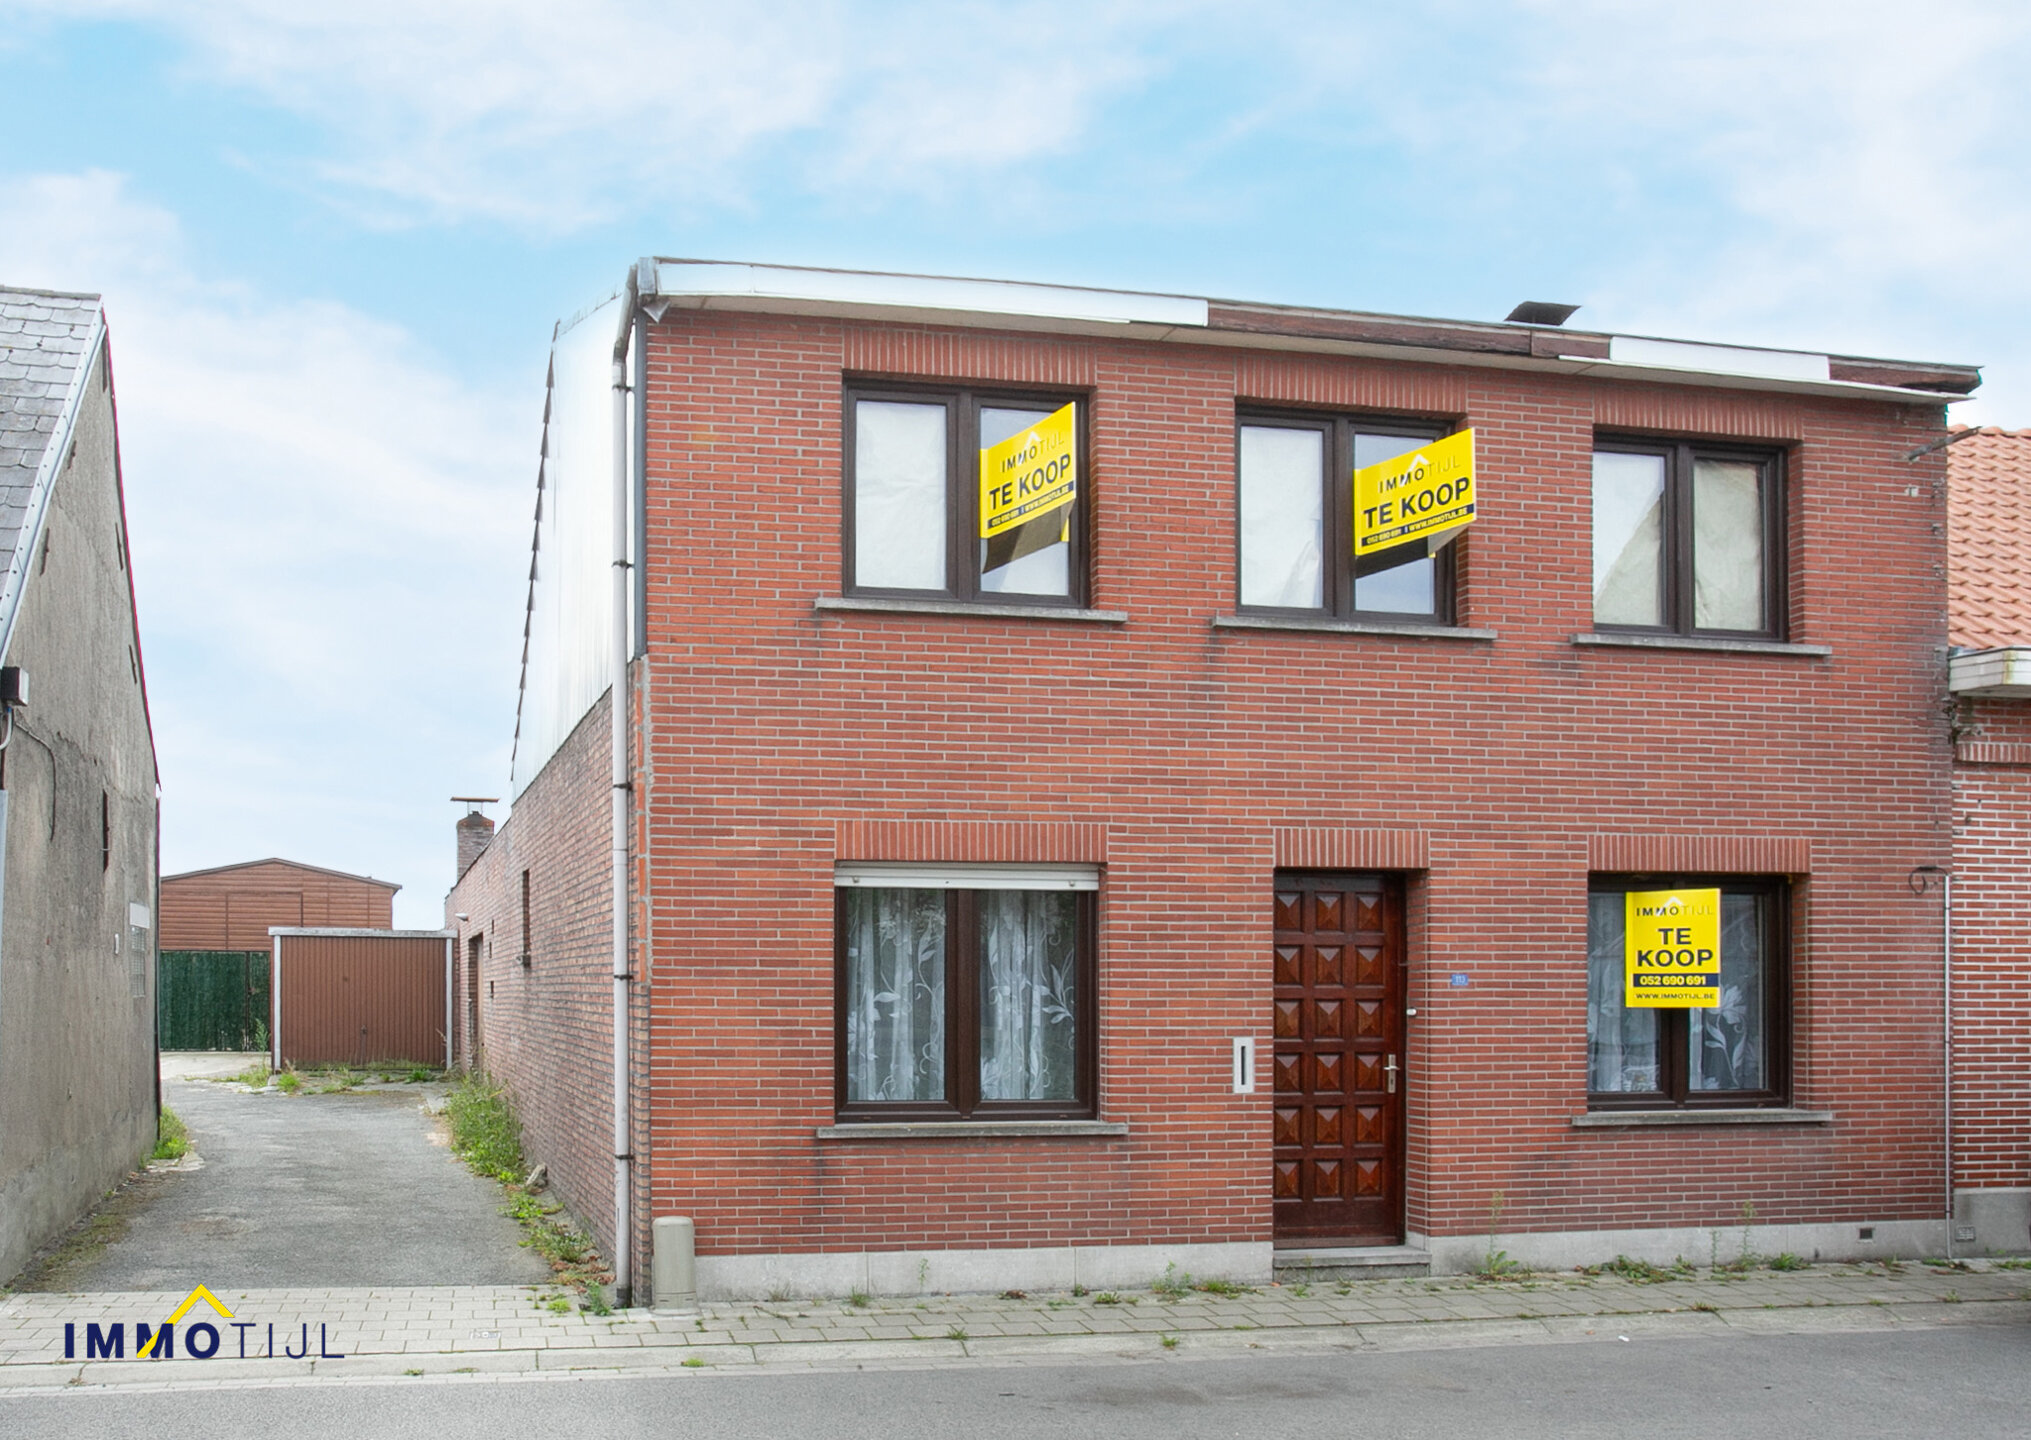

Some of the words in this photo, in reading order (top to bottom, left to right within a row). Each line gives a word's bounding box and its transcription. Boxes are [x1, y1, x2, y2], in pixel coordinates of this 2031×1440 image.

[1002, 431, 1065, 472] IMMOTIJL
[989, 482, 1013, 510] TE
[1019, 453, 1071, 499] KOOP
[1379, 455, 1460, 493] IMMOTIJL
[1363, 502, 1393, 529] TE
[1401, 477, 1470, 518] KOOP
[1636, 905, 1714, 917] IMMOTIJL
[1658, 927, 1692, 945] TE
[1636, 949, 1714, 967] KOOP
[1640, 975, 1662, 986] 052
[1662, 975, 1685, 986] 690
[1686, 975, 1707, 986] 691
